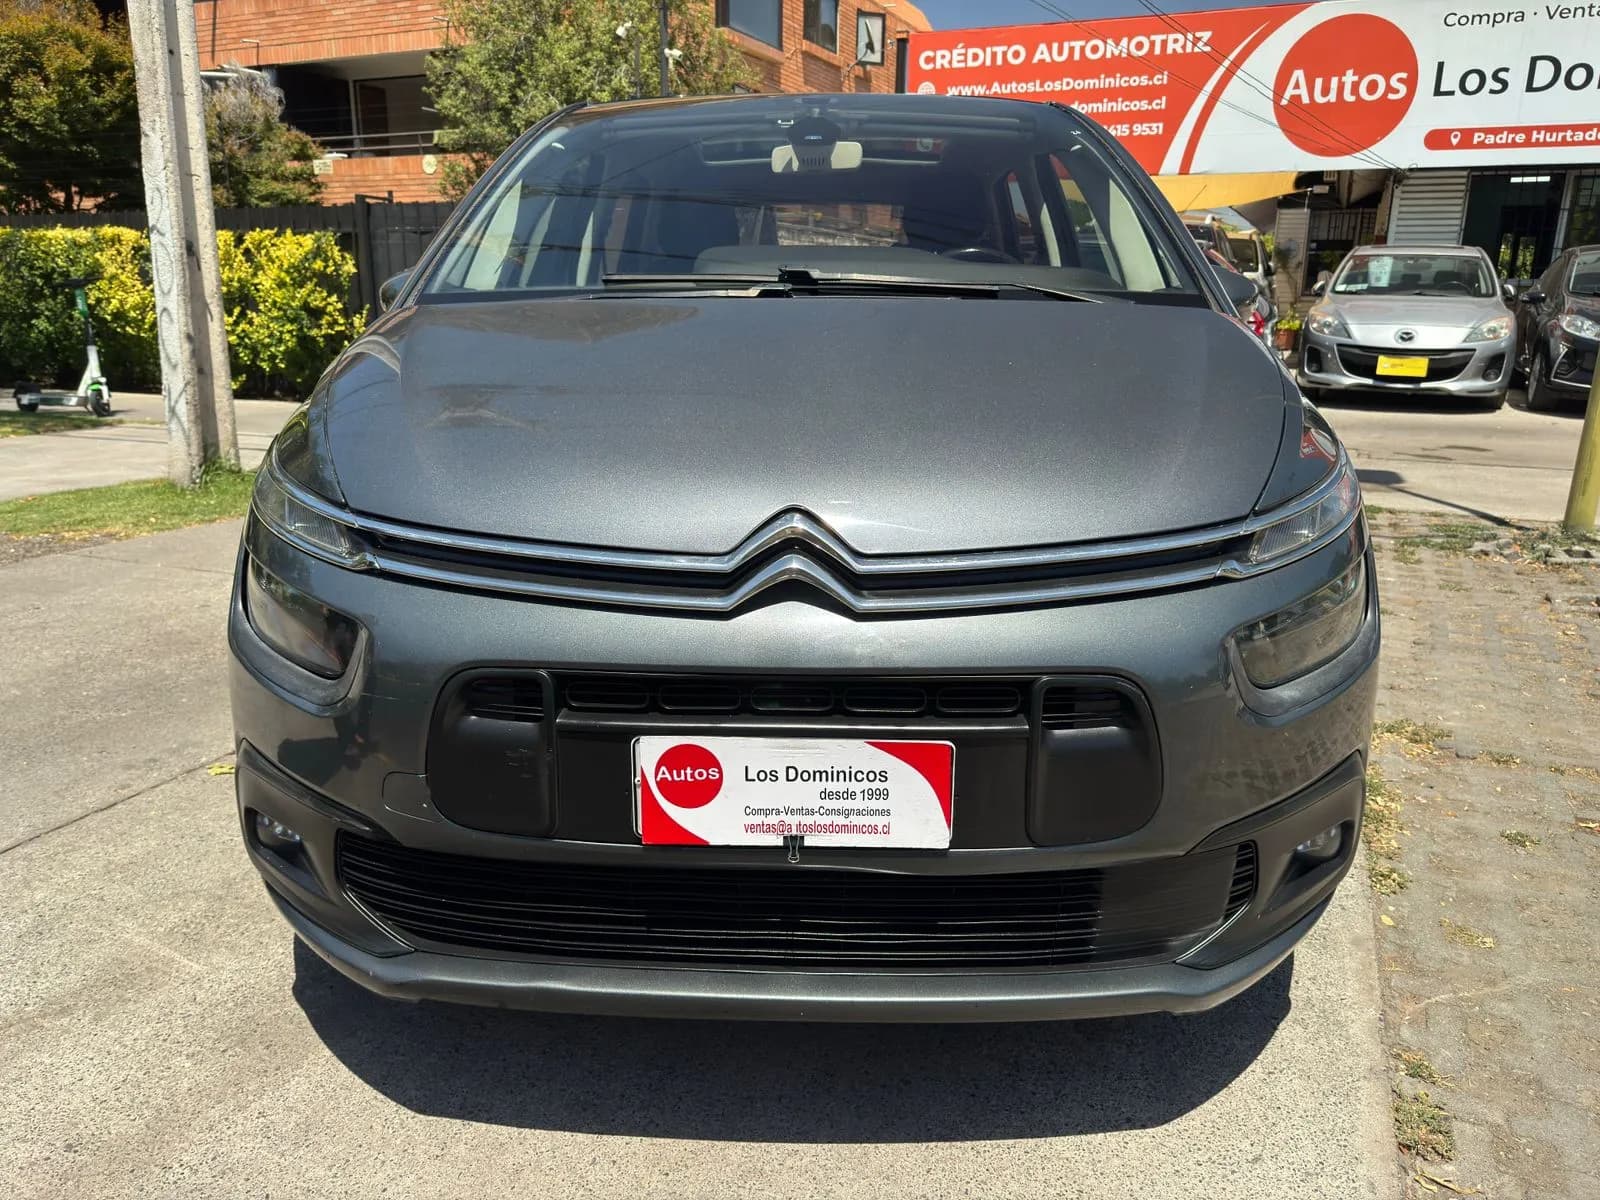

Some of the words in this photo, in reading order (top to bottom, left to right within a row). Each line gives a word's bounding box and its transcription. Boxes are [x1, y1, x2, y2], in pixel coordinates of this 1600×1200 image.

[1443, 10, 1526, 28] Compra
[918, 43, 1026, 70] CRÉDITO
[1032, 31, 1213, 64] AUTOMOTRIZ
[1432, 60, 1510, 97] Los
[1525, 55, 1600, 93] Do
[1279, 68, 1409, 106] Autos
[1069, 96, 1166, 114] dominicos.cl
[1132, 122, 1164, 136] 9531
[1472, 130, 1526, 145] Padre
[1531, 127, 1600, 144] Hurtad
[655, 765, 720, 782] Autos
[744, 766, 779, 782] Los
[785, 766, 889, 783] Dominicos
[819, 788, 857, 801] desde
[860, 788, 890, 801] 1999
